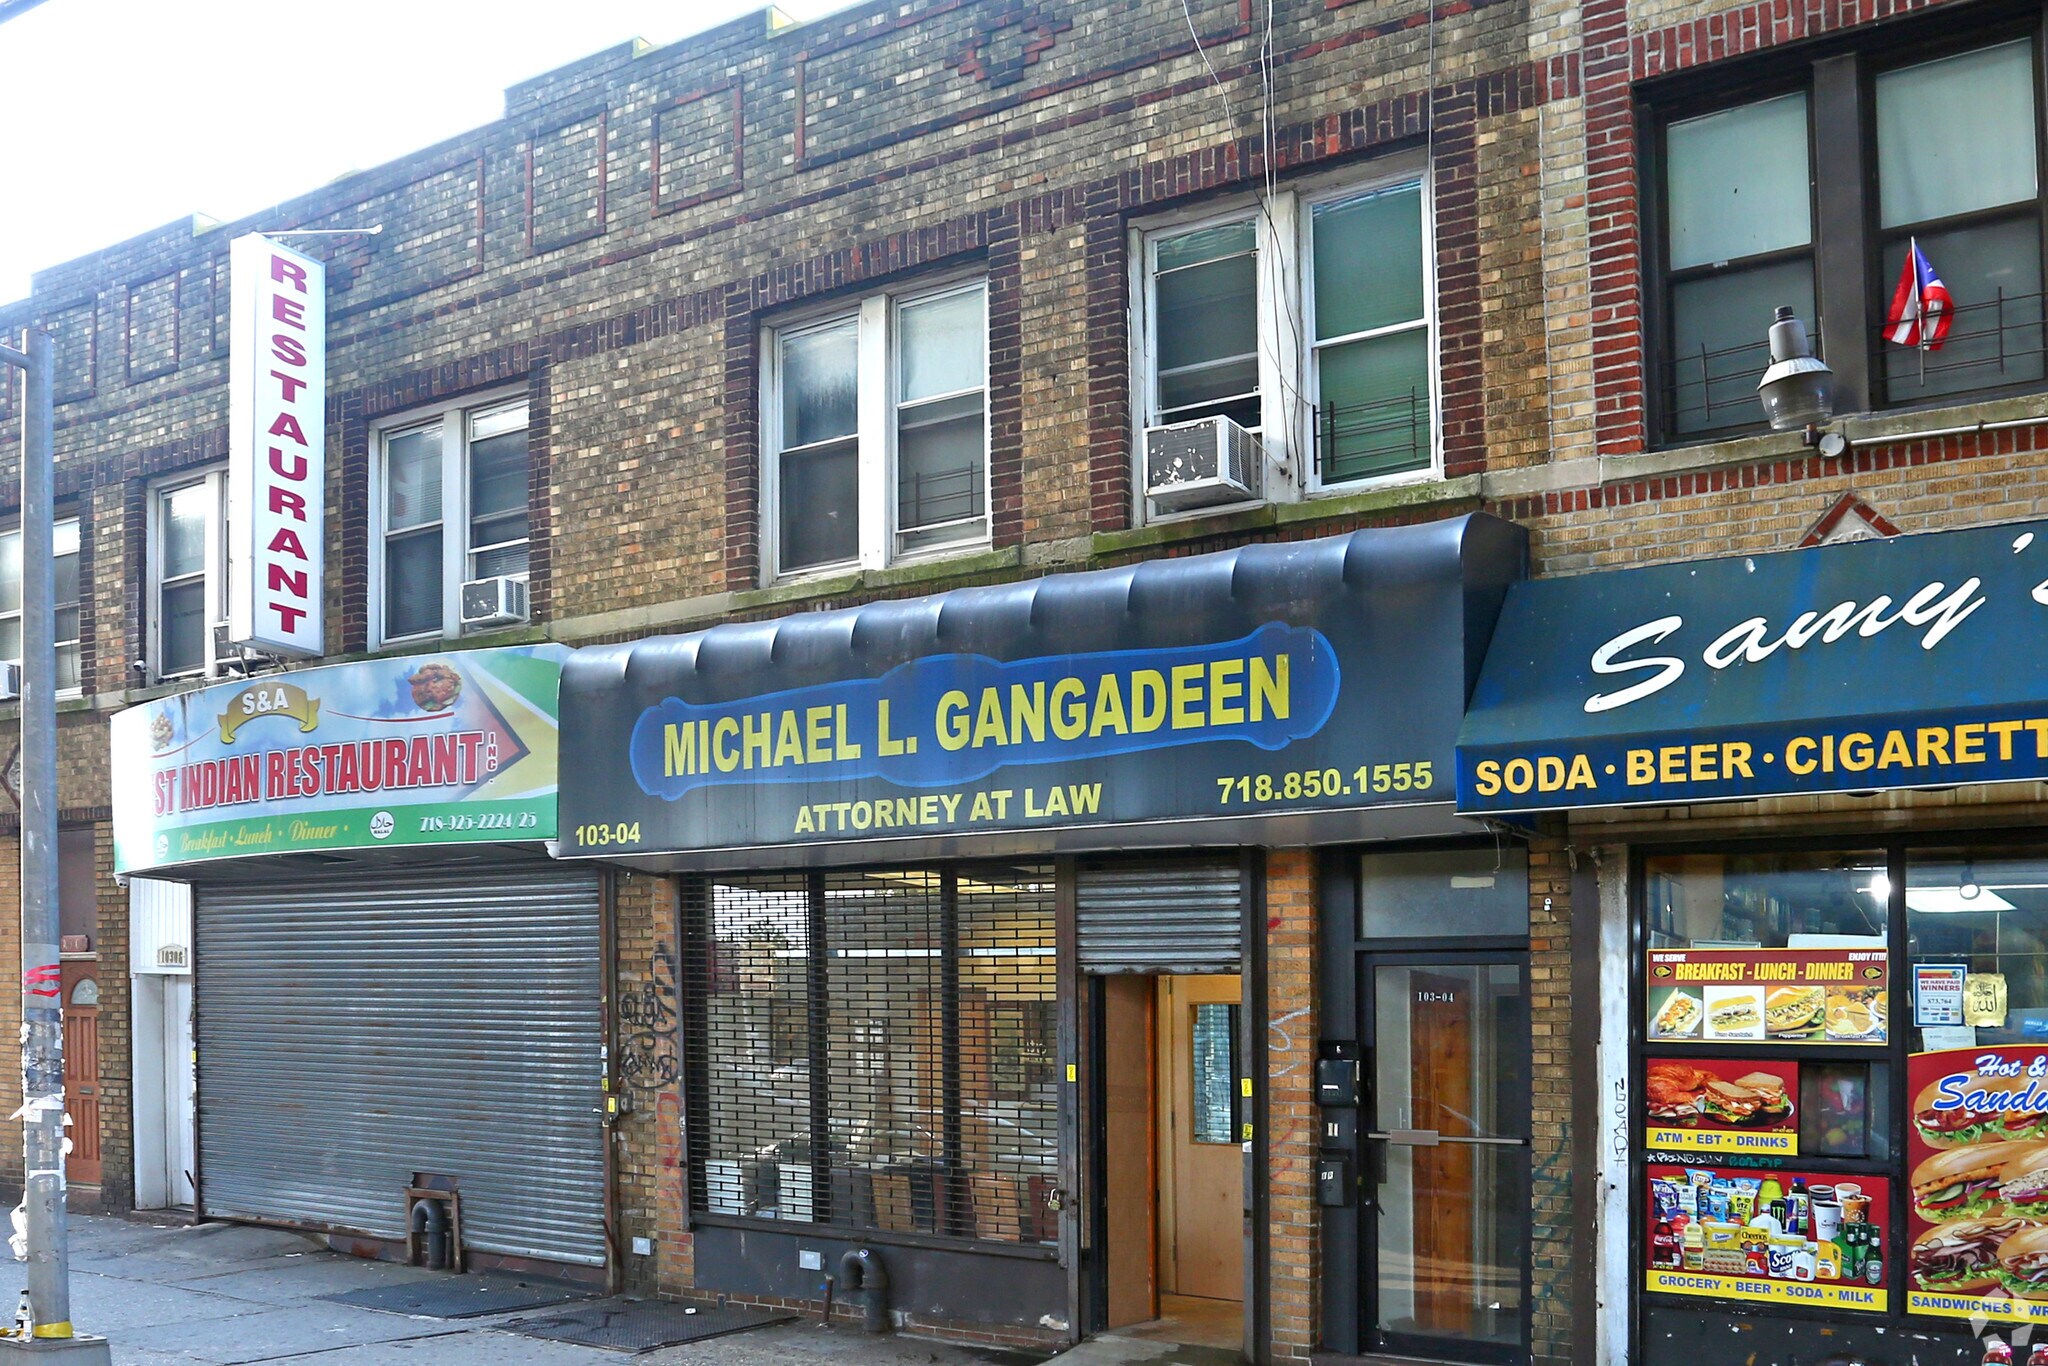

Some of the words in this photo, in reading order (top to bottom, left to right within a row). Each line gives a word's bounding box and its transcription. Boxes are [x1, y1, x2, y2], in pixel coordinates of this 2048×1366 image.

[268, 254, 309, 634] RESTAURANT
[242, 687, 289, 715] S&A
[664, 704, 861, 777] MICHAEL
[877, 699, 917, 756] L.
[935, 653, 1289, 751] GANGADEEN
[1475, 753, 1597, 796] SODA
[1626, 741, 1754, 785] BEER
[1785, 716, 2048, 775] CIGARETT
[149, 767, 177, 816] ST
[179, 753, 260, 812] INDIAN
[265, 731, 484, 800] RESTAURANT
[1216, 761, 1433, 804] 718.850.1555
[794, 793, 962, 834] ATTORNEY
[969, 790, 1012, 821] AT
[1024, 783, 1102, 818] LAW
[180, 829, 227, 853] Breakfast
[234, 823, 273, 846] Lunch
[288, 819, 339, 842] Dinner
[575, 822, 641, 847] 103-04
[1652, 953, 1664, 962] WE
[1664, 953, 1686, 962] SERVE
[1848, 952, 1871, 961] ENJOY
[1675, 963, 1746, 980] BREAKFAST
[1754, 963, 1797, 980] LUNCH
[1805, 963, 1854, 980] DINNER
[1418, 991, 1455, 1003] 103-04
[1920, 984, 1961, 992] WINNERS
[1975, 1054, 2021, 1076] Hot
[2028, 1055, 2047, 1076] &
[1655, 1132, 1683, 1143] ATM
[1696, 1134, 1723, 1145] EBT
[1736, 1136, 1789, 1148] DRINKS
[1658, 1275, 1722, 1290] GROCERY
[1735, 1281, 1771, 1295] BEER
[1785, 1285, 1823, 1299] SODA
[1838, 1290, 1874, 1303] MILK
[1911, 1295, 2012, 1314] SANDWICHES
